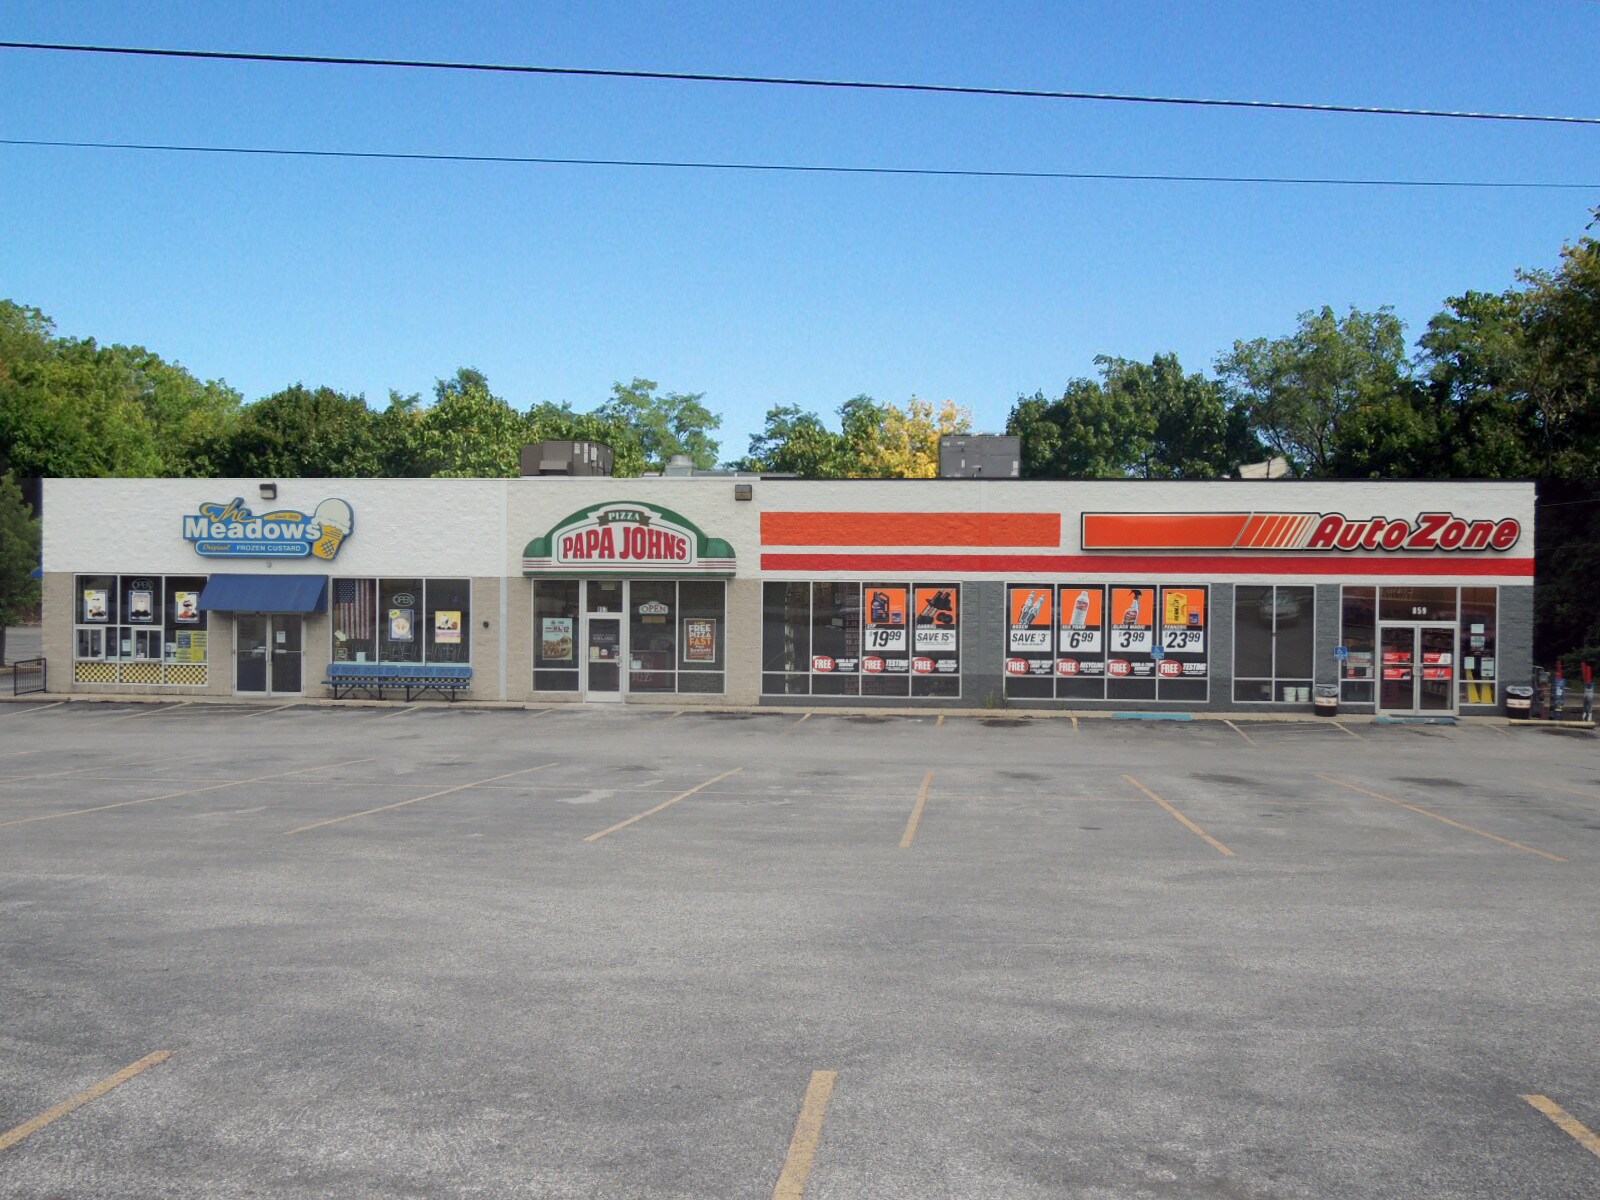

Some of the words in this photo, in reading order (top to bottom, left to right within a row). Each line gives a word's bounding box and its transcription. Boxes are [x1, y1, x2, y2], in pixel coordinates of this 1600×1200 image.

[201, 498, 256, 522] The
[608, 512, 640, 521] PIZZA
[185, 518, 322, 540] Meadows
[1305, 514, 1519, 550] AutoZone
[562, 527, 616, 559] PAPA
[619, 526, 687, 560] JOHN'S
[394, 595, 414, 605] OPEN
[641, 604, 667, 613] OPEN
[1412, 606, 1427, 615] 859
[688, 624, 711, 632] FREE
[689, 638, 712, 646] FAST
[917, 633, 940, 642] SAVE
[1012, 633, 1036, 642] SAVE
[814, 659, 832, 669] FREE
[864, 660, 881, 669] FREE
[885, 659, 909, 667] TESTING
[913, 660, 931, 670] FREE
[1007, 662, 1025, 671] FREE
[1059, 662, 1077, 672] FREE
[1109, 663, 1127, 673] FREE
[1160, 663, 1178, 673] FREE
